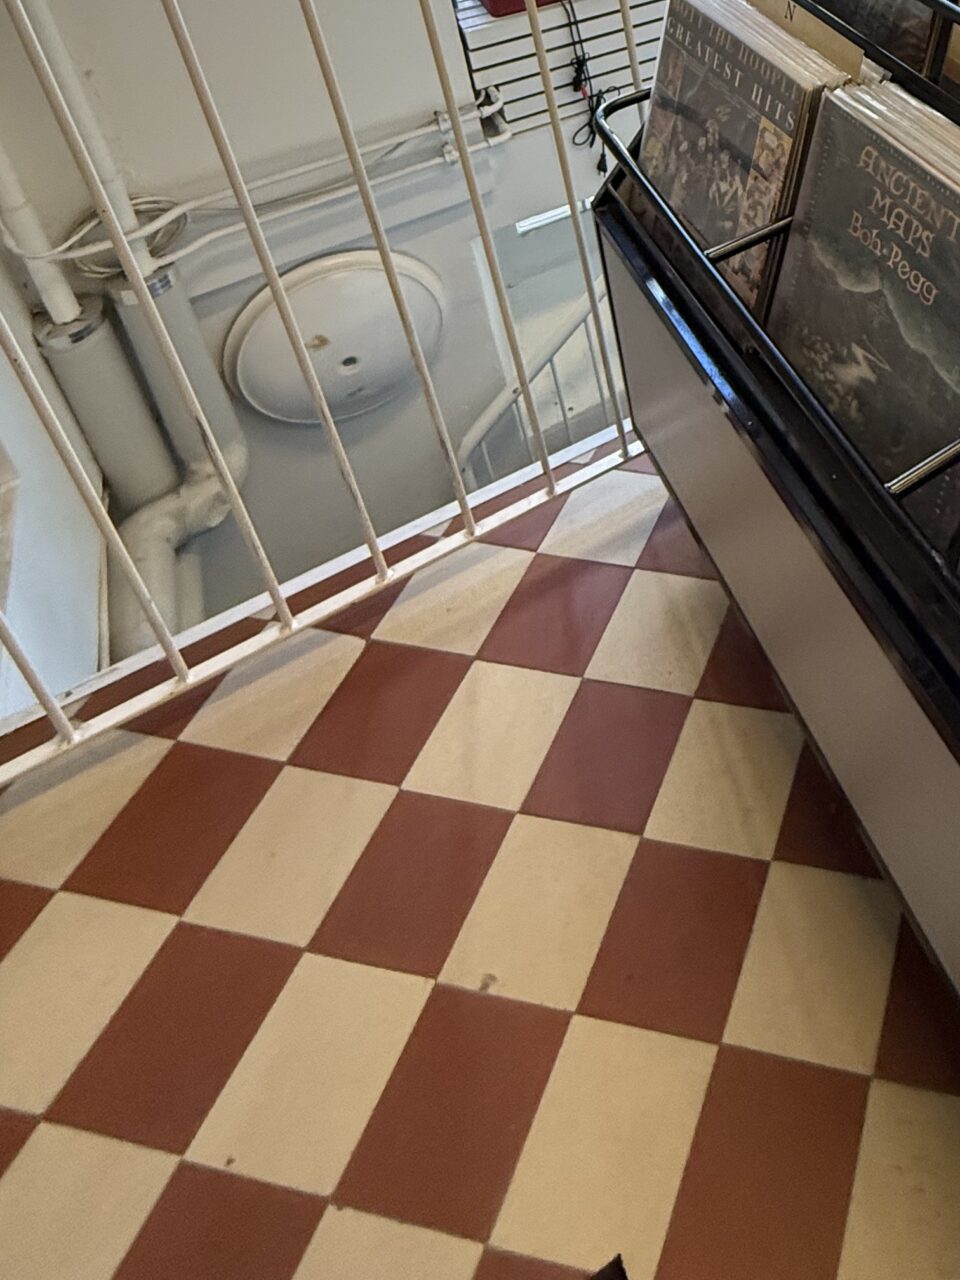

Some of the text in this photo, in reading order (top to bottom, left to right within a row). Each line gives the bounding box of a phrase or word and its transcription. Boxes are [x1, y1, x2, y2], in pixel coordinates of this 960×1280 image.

[784, 0, 797, 22] N
[666, 16, 797, 132] GREATEST HITS
[868, 186, 937, 259] MAPS
[887, 242, 941, 306] Pegg
